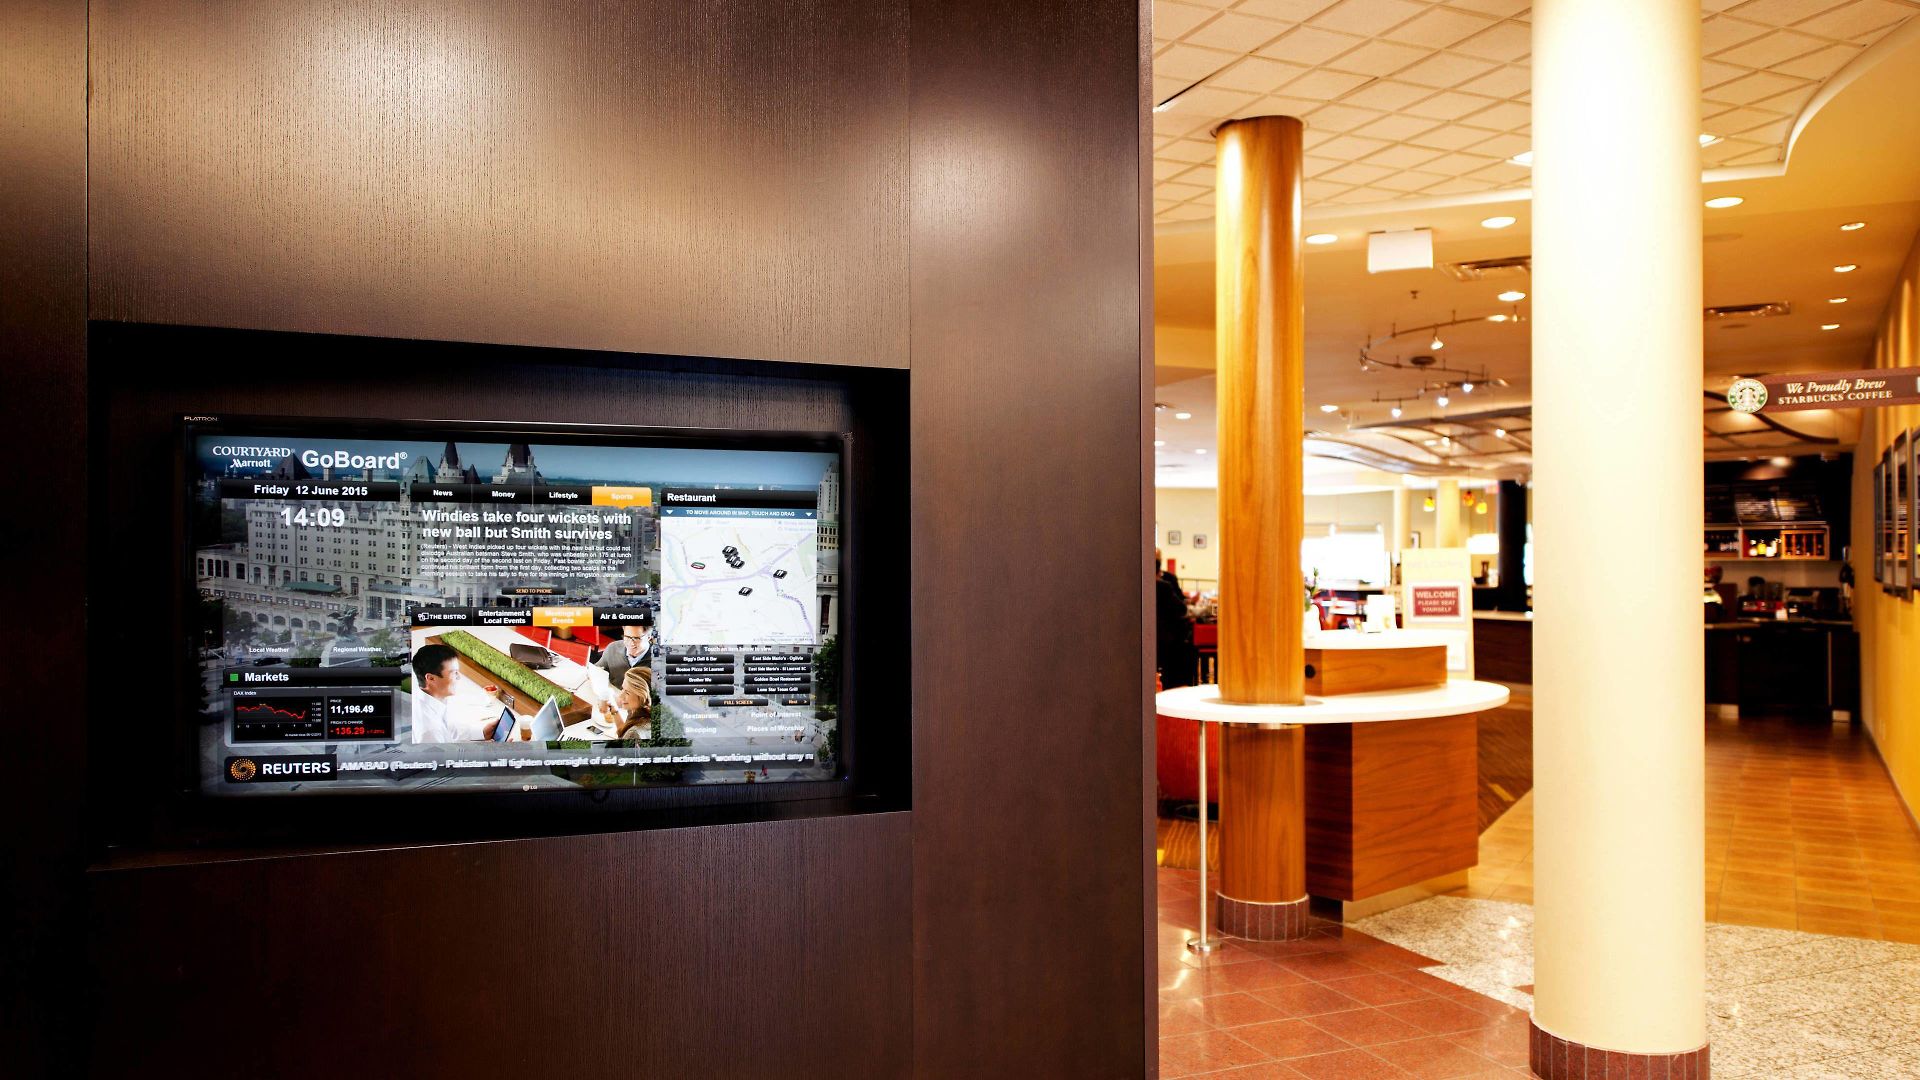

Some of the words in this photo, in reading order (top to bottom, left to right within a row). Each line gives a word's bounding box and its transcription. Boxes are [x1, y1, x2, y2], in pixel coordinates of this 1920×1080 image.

[1786, 383, 1803, 394] We
[1807, 379, 1851, 393] Proudly
[1855, 379, 1886, 390] Brew
[1778, 393, 1844, 404] STARBUCKS
[1848, 390, 1892, 400] COFFEE
[230, 458, 271, 468] Marriott
[254, 484, 289, 496] Friday
[296, 485, 309, 495] 12
[311, 485, 339, 496] June
[342, 486, 368, 496] 2015
[492, 490, 515, 499] Money
[549, 492, 578, 500] Lifestyle
[667, 493, 716, 502] Restaurant
[280, 507, 345, 528] 14:09
[422, 509, 479, 523] Windies
[483, 510, 512, 523] take
[516, 511, 544, 524] four
[548, 512, 599, 524] wickets
[603, 512, 632, 525] with
[422, 528, 452, 537] new
[456, 526, 481, 538] ball
[485, 527, 508, 538] but
[511, 527, 551, 539] Smith
[555, 528, 612, 540] survives
[244, 673, 289, 682] Markets
[331, 705, 374, 714] 11,196.49
[336, 727, 365, 735] 136.29
[337, 760, 388, 771] AMABAD
[390, 760, 437, 771] (Reuters)
[446, 760, 488, 768] Pakistan
[491, 759, 507, 768] will
[509, 758, 542, 768] tighten
[544, 757, 589, 766] oversight
[589, 756, 600, 764] of
[601, 756, 617, 764] aid
[618, 757, 651, 766] groups
[653, 755, 671, 763] and
[672, 754, 710, 763] activists
[711, 754, 752, 763] "working
[753, 753, 785, 762] without
[262, 762, 331, 775] REUTERS
